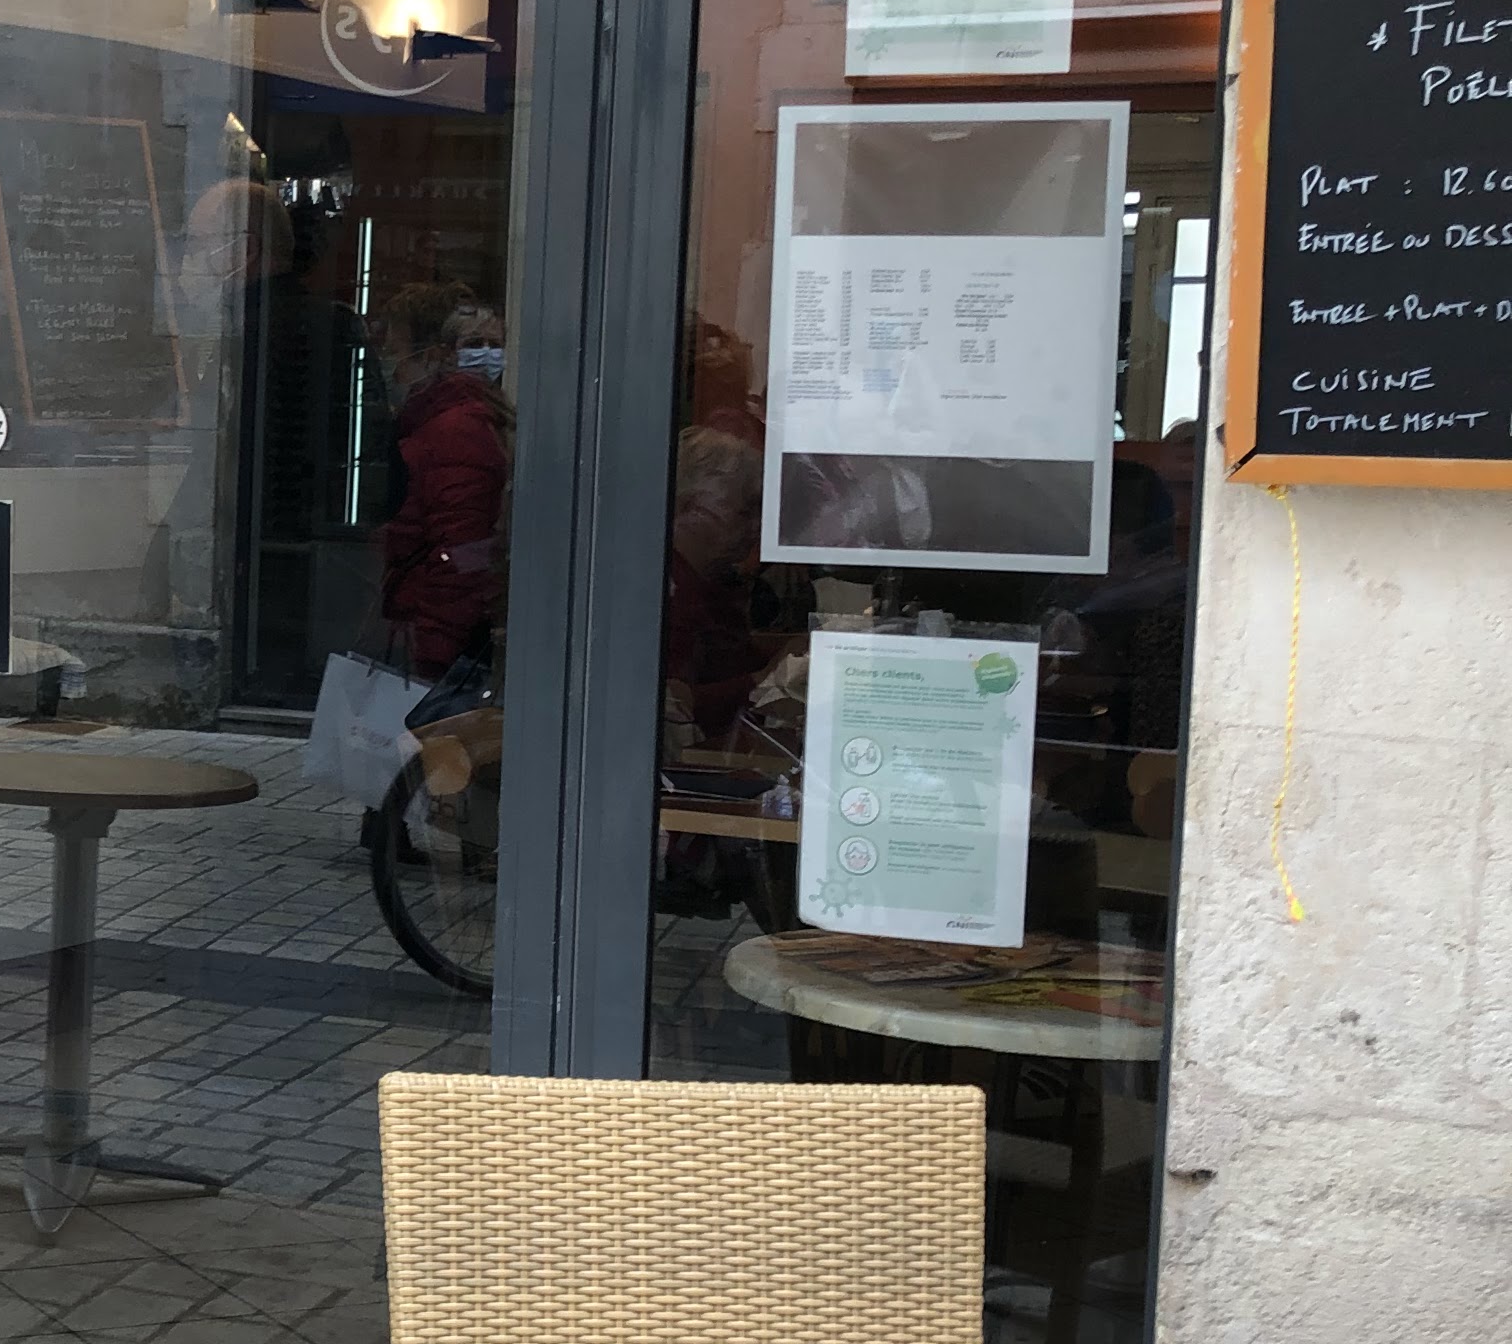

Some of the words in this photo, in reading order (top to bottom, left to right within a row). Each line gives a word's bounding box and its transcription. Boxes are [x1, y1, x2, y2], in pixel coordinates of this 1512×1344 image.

[1301, 164, 1379, 207] PLAT
[1299, 222, 1394, 254] ENTRÉE
[1292, 367, 1436, 393] CUISINE
[1278, 406, 1489, 435] TOTALEMENT
